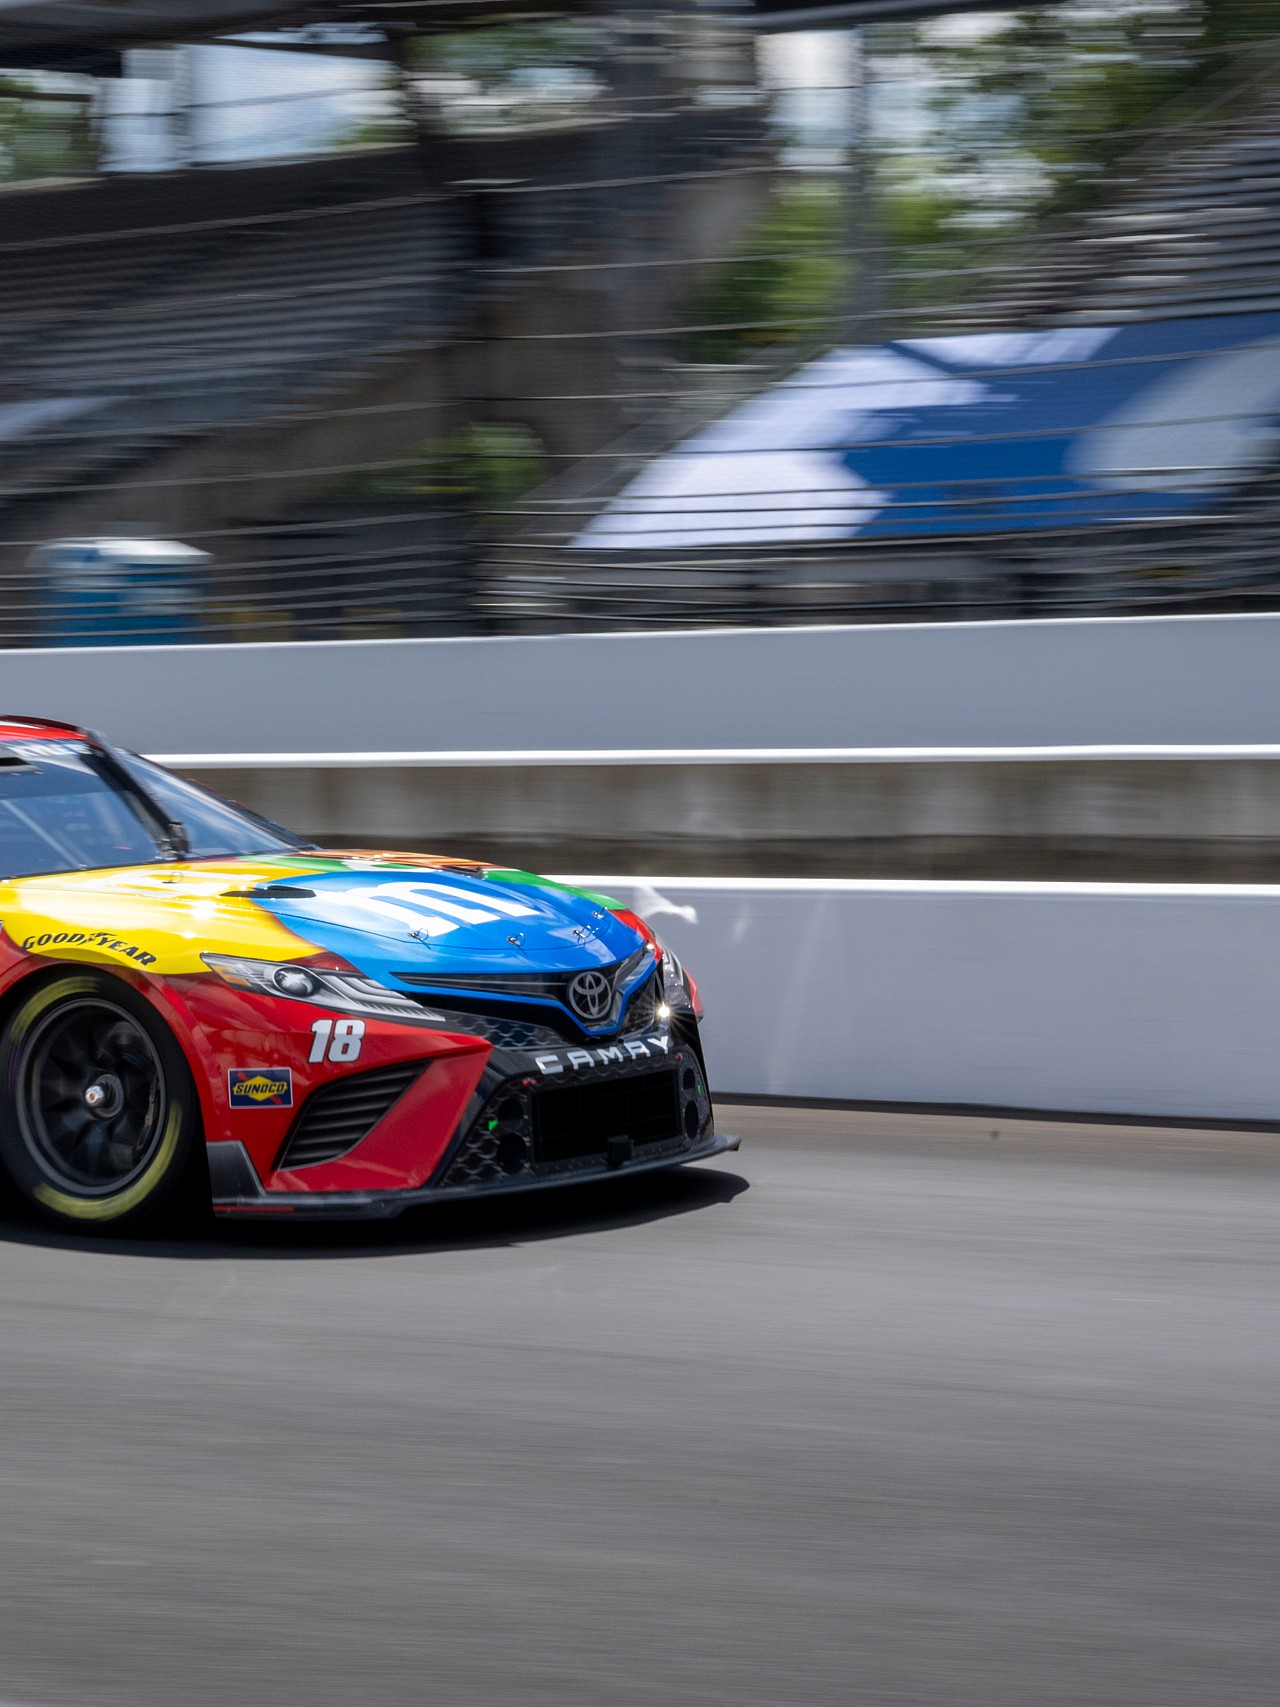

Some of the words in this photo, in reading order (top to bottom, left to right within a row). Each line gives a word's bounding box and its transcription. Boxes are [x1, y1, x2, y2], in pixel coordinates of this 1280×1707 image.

[307, 1018, 366, 1064] 18
[535, 1035, 669, 1075] CAMRY
[234, 1082, 287, 1095] SUNOCO
